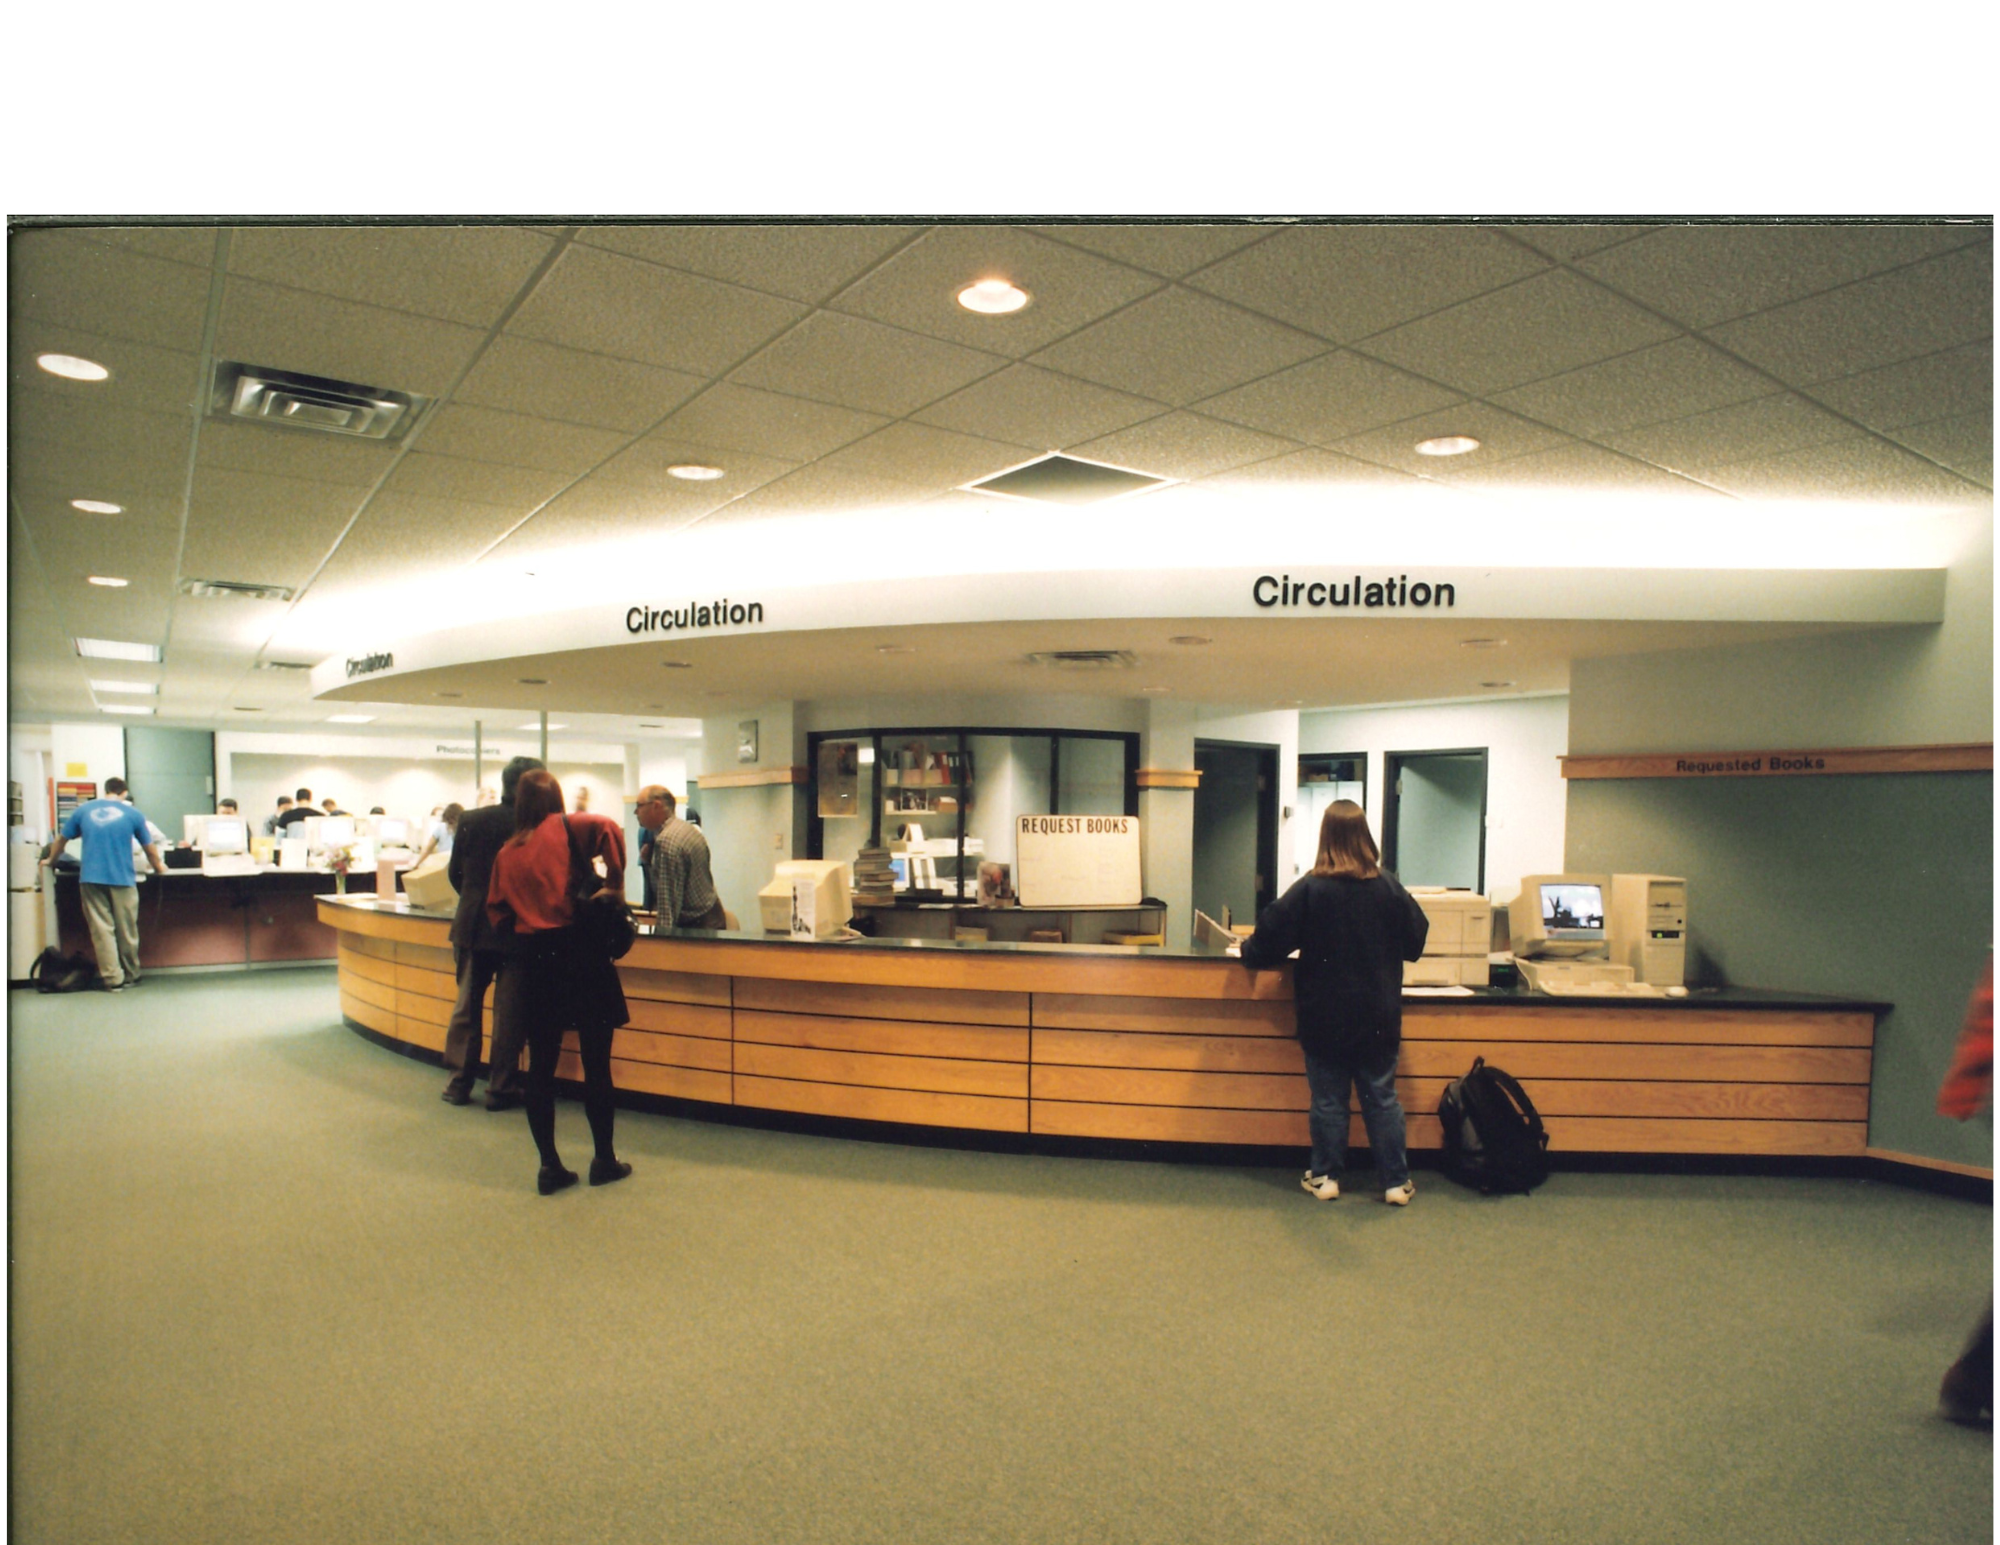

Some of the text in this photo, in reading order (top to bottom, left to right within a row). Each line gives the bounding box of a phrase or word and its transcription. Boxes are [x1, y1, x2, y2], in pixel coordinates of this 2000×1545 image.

[1253, 575, 1455, 607] Circulation
[626, 598, 763, 633] Circulation
[346, 652, 393, 678] Circulation
[436, 744, 501, 755] Photocoiers
[1676, 756, 1825, 773] Requested Books
[1021, 818, 1128, 835] REQUEST BOOKS
